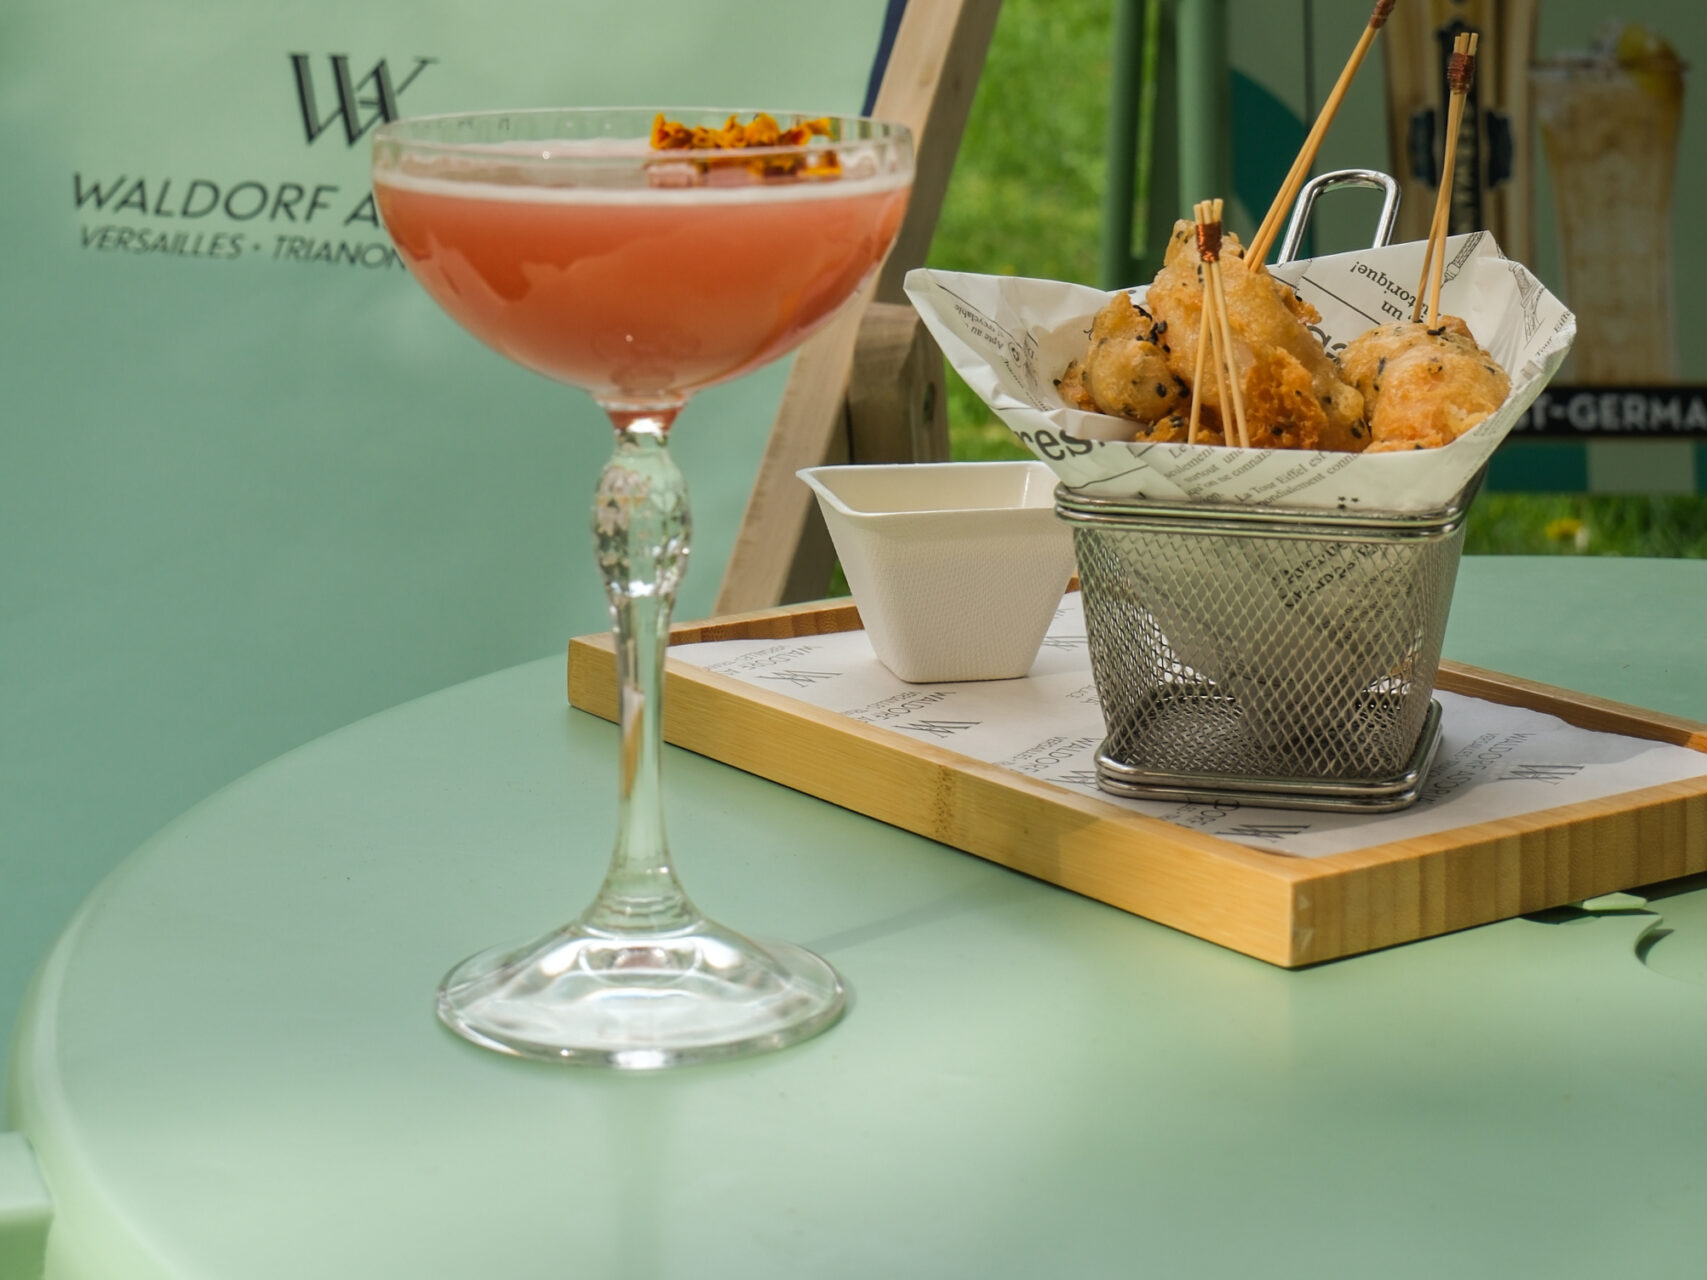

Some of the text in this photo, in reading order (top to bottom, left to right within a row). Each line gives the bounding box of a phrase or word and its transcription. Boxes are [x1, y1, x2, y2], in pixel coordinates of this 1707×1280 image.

[72, 172, 340, 224] WALDORF
[79, 225, 244, 261] VERSAILLES
[1275, 464, 1309, 486] Eiffel
